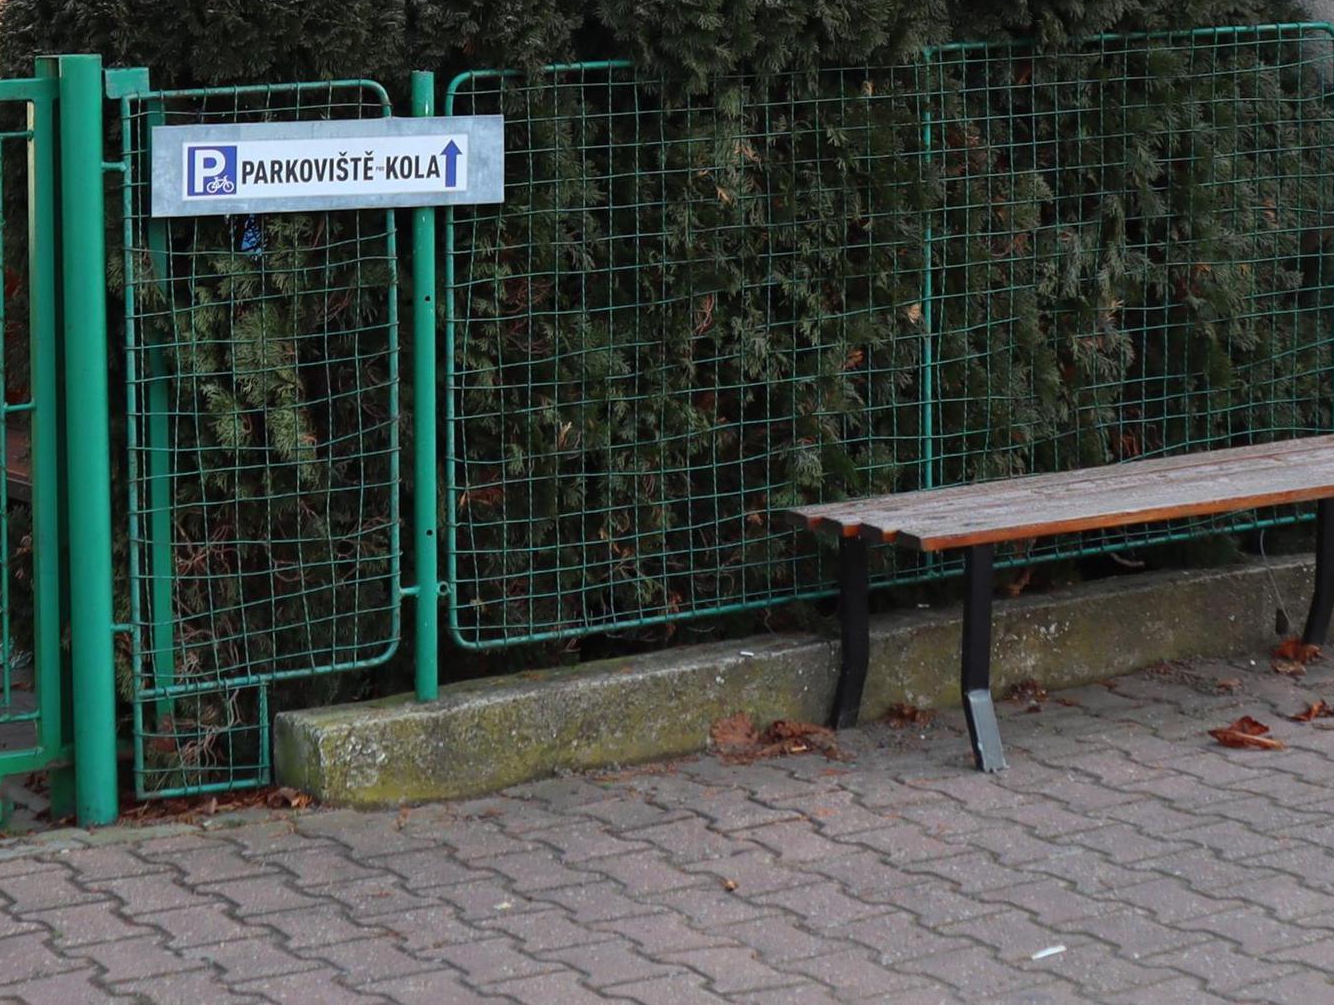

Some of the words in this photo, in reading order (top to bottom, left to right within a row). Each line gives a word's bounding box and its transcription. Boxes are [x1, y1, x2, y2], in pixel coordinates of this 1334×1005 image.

[194, 149, 226, 194] P
[241, 150, 375, 185] PARKOVIŠTĚ
[386, 154, 441, 180] KOLA
